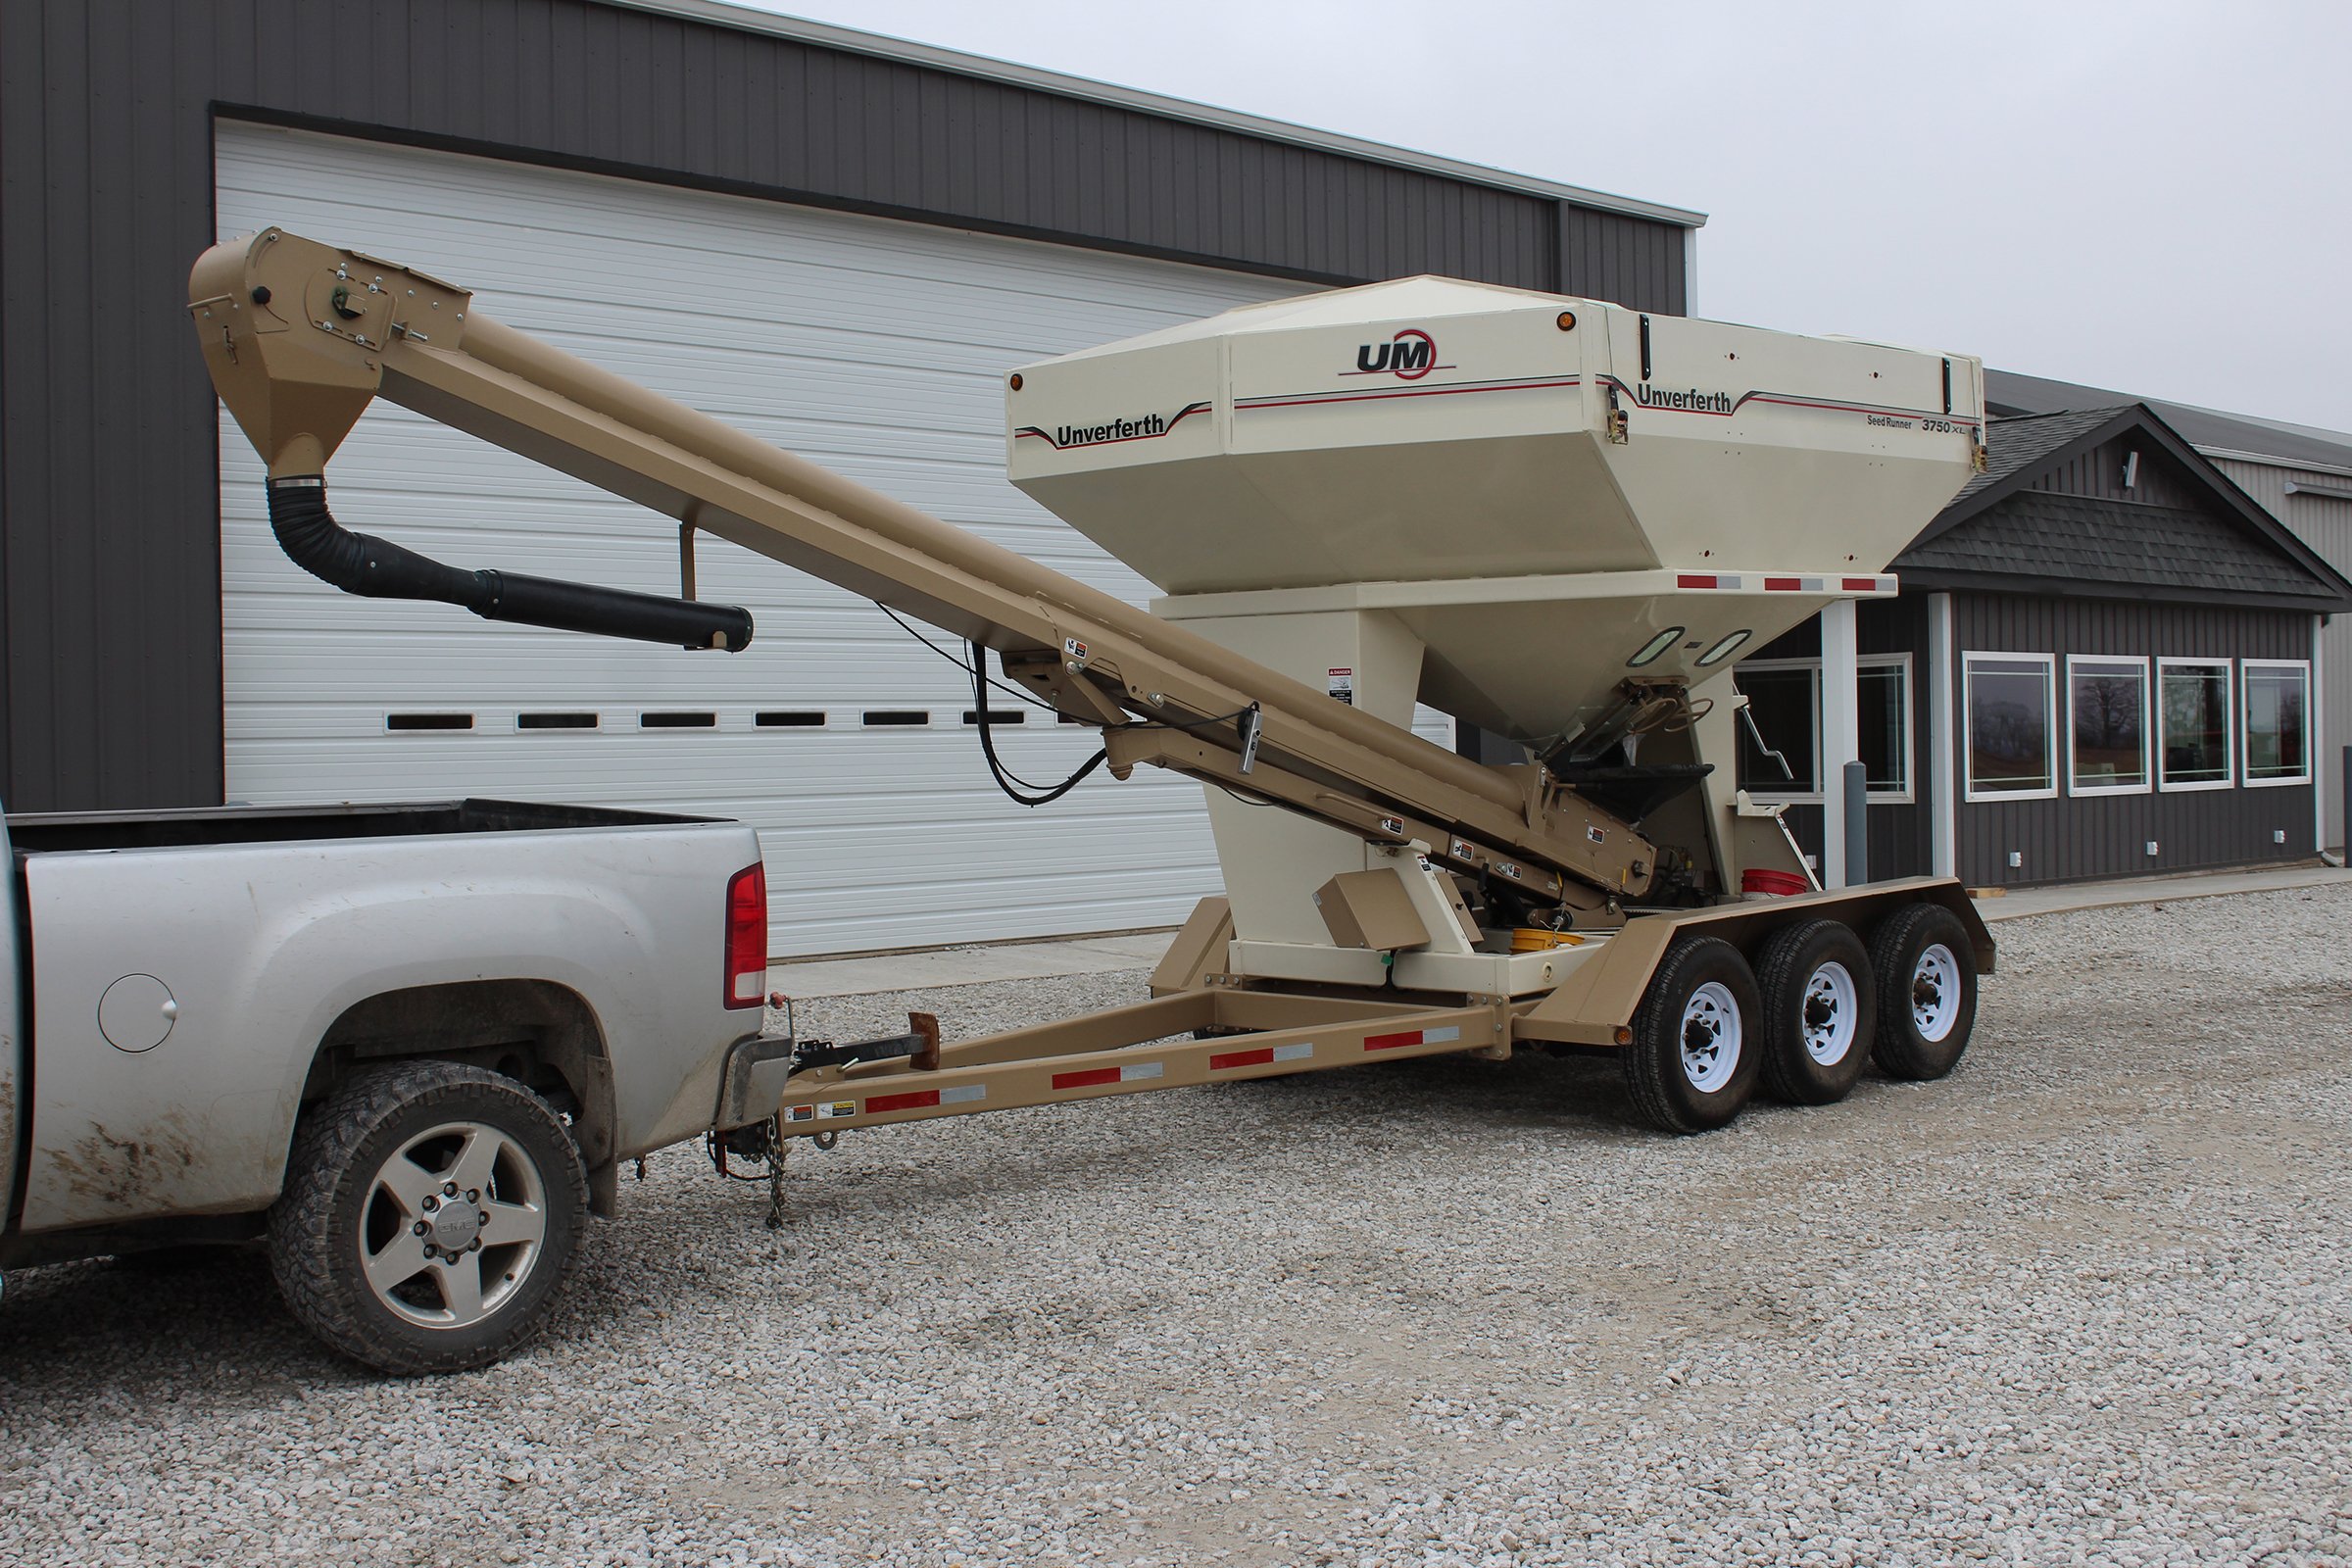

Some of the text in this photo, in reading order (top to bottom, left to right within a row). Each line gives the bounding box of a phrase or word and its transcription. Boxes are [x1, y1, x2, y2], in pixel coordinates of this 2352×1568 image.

[1357, 341, 1430, 371] UM
[1639, 383, 1731, 413] Unverferth
[1058, 414, 1164, 446] Unverferth
[1922, 419, 1950, 433] 3750
[1951, 425, 1966, 434] XL
[439, 1217, 475, 1233] GMC
